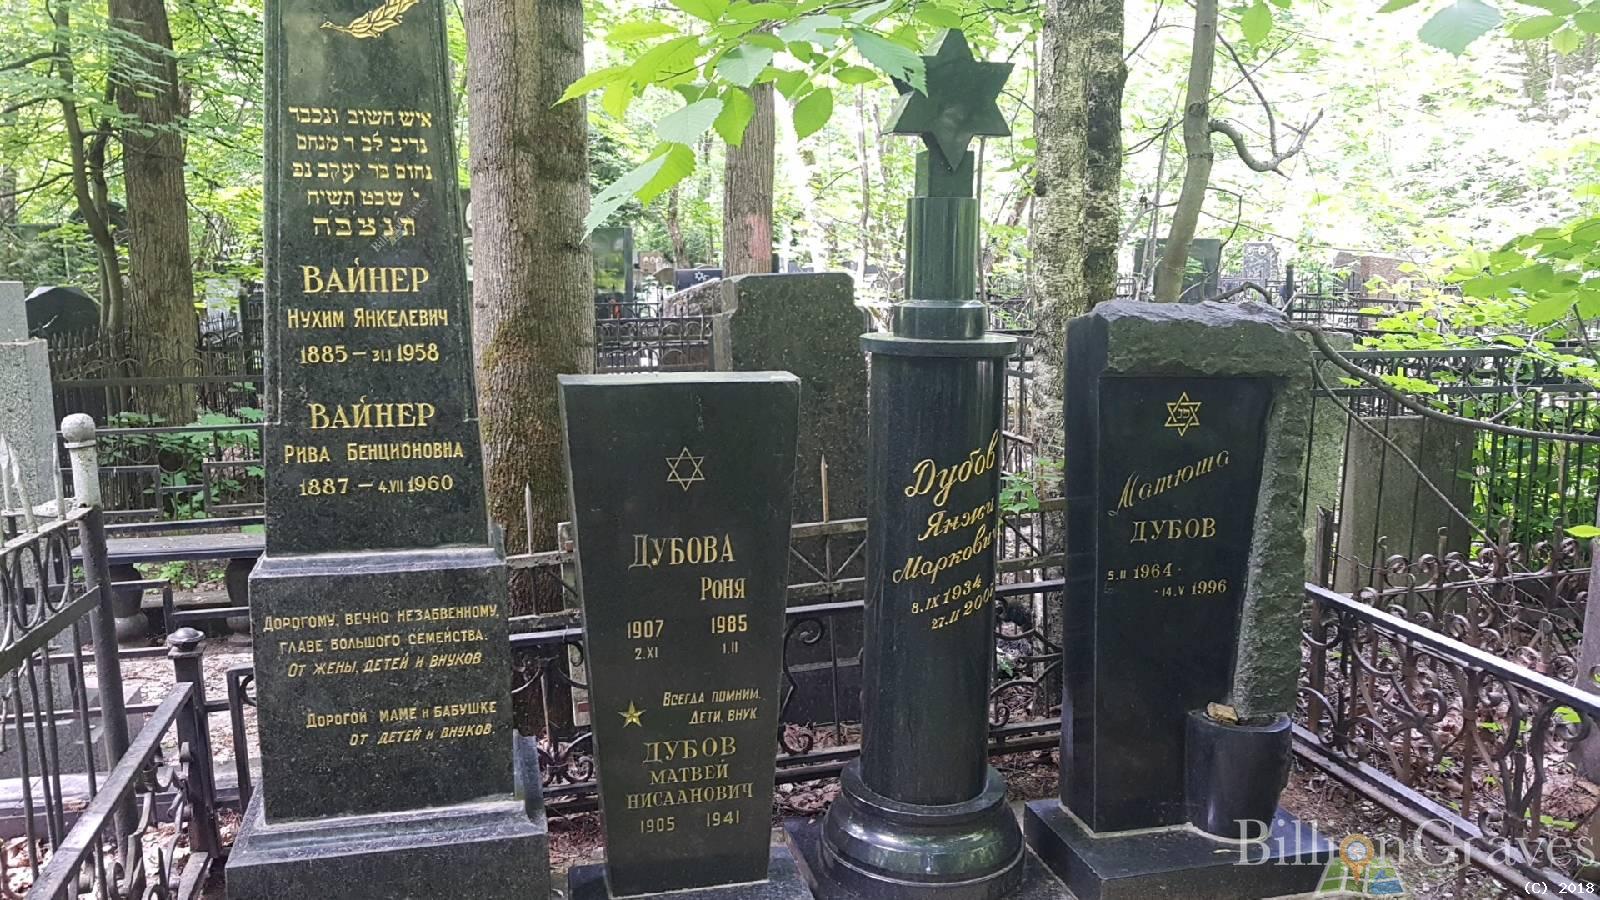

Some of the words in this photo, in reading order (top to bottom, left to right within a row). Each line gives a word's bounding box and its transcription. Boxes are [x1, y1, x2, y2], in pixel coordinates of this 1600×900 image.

[347, 109, 395, 126] חשוב
[398, 110, 432, 128] איש
[296, 133, 339, 151] מנחם
[360, 130, 383, 152] לב
[390, 136, 428, 154] נדיב
[317, 161, 361, 184] יעקב
[394, 163, 433, 180] נחום
[360, 190, 404, 206] שבט
[301, 257, 430, 293] ВАЙНЕР
[287, 308, 345, 328] НУХИМ
[353, 307, 449, 328] ЯНКЕЛЕВИЧ
[300, 345, 348, 365] 1885
[396, 342, 440, 363] 1958
[307, 394, 436, 430] ВАЙНЕР
[284, 443, 331, 464] РИВА
[904, 428, 1000, 508] Дубов
[300, 477, 350, 496] 1887
[407, 474, 454, 494] 1960
[1107, 450, 1230, 517] Матюша
[1130, 517, 1217, 544] ДУБОВ
[627, 533, 736, 569] ДУБОВА
[1133, 562, 1173, 579] 1964
[700, 576, 746, 601] РОНЯ
[942, 573, 982, 604] 1934
[1191, 579, 1228, 596] 1996
[345, 611, 389, 626] ВЕЧНО
[627, 619, 665, 639] 1907
[711, 614, 748, 634] 1985
[279, 638, 324, 656] ГЛАВЕ
[331, 633, 401, 651] БОЛЬШОГО
[287, 661, 307, 678] ОТ
[362, 651, 409, 673] ДЕТЕЙ
[415, 655, 425, 668] И
[662, 690, 705, 707] ВСЕГДА
[305, 706, 369, 729] ДОРОГОЙ
[379, 706, 417, 723] МАМЕ
[433, 701, 498, 718] БАБУШКЕ
[727, 706, 758, 722] ВНУК
[349, 733, 369, 746] ОТ
[377, 726, 422, 745] ДЕТЕЙ
[642, 736, 737, 764] ДУБОВ
[650, 758, 729, 785] МАТВЕЙ
[626, 782, 754, 810] НИСААНОВИЧ
[640, 816, 676, 833] 1905
[706, 810, 740, 828] 1941
